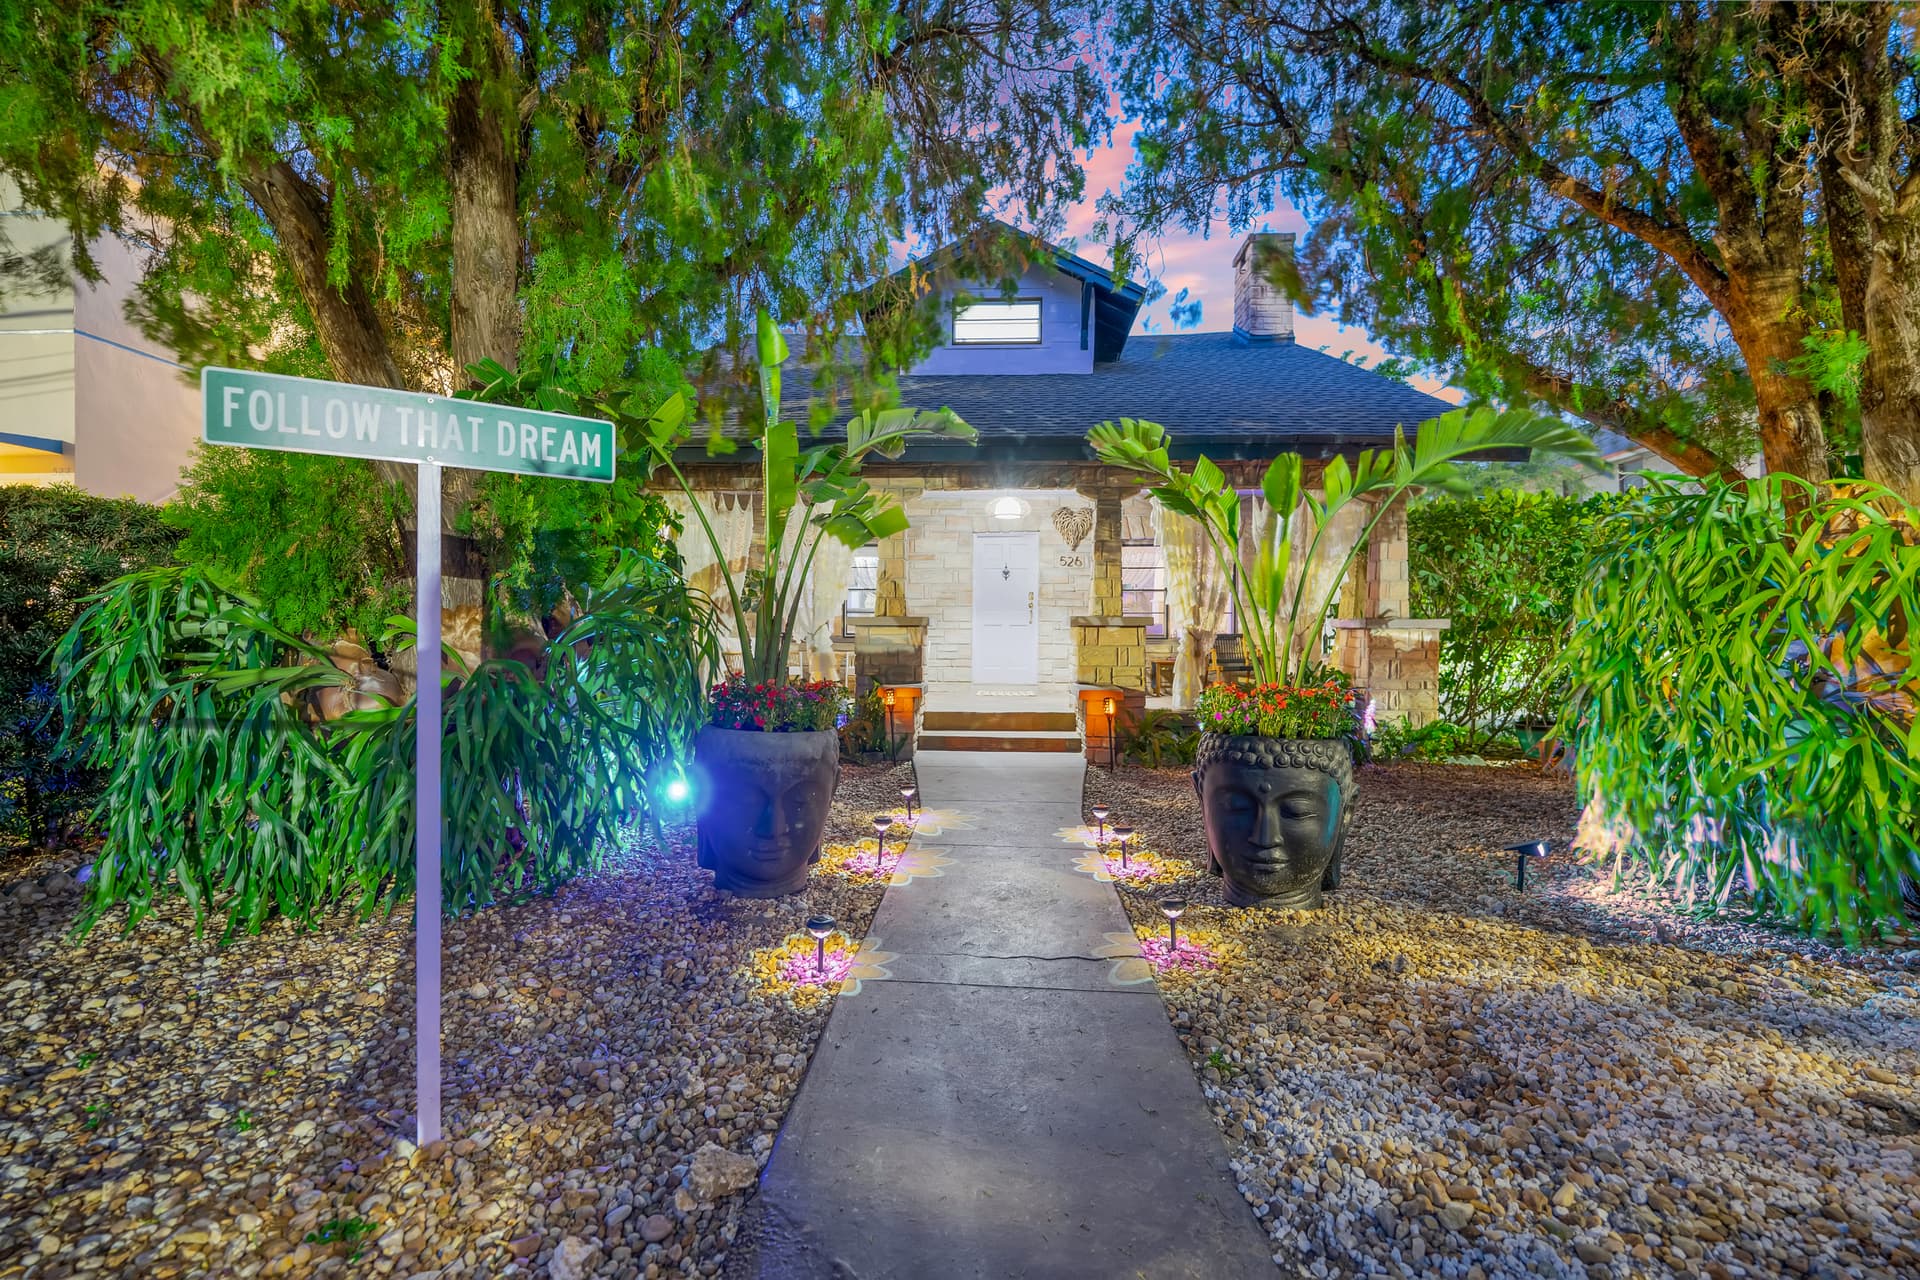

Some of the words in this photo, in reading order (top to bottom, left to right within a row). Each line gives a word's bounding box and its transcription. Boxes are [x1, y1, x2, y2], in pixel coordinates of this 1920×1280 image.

[222, 386, 382, 442] FOLLOW
[395, 406, 485, 454] THAT
[497, 421, 602, 468] DREAM
[1059, 555, 1083, 567] 526
